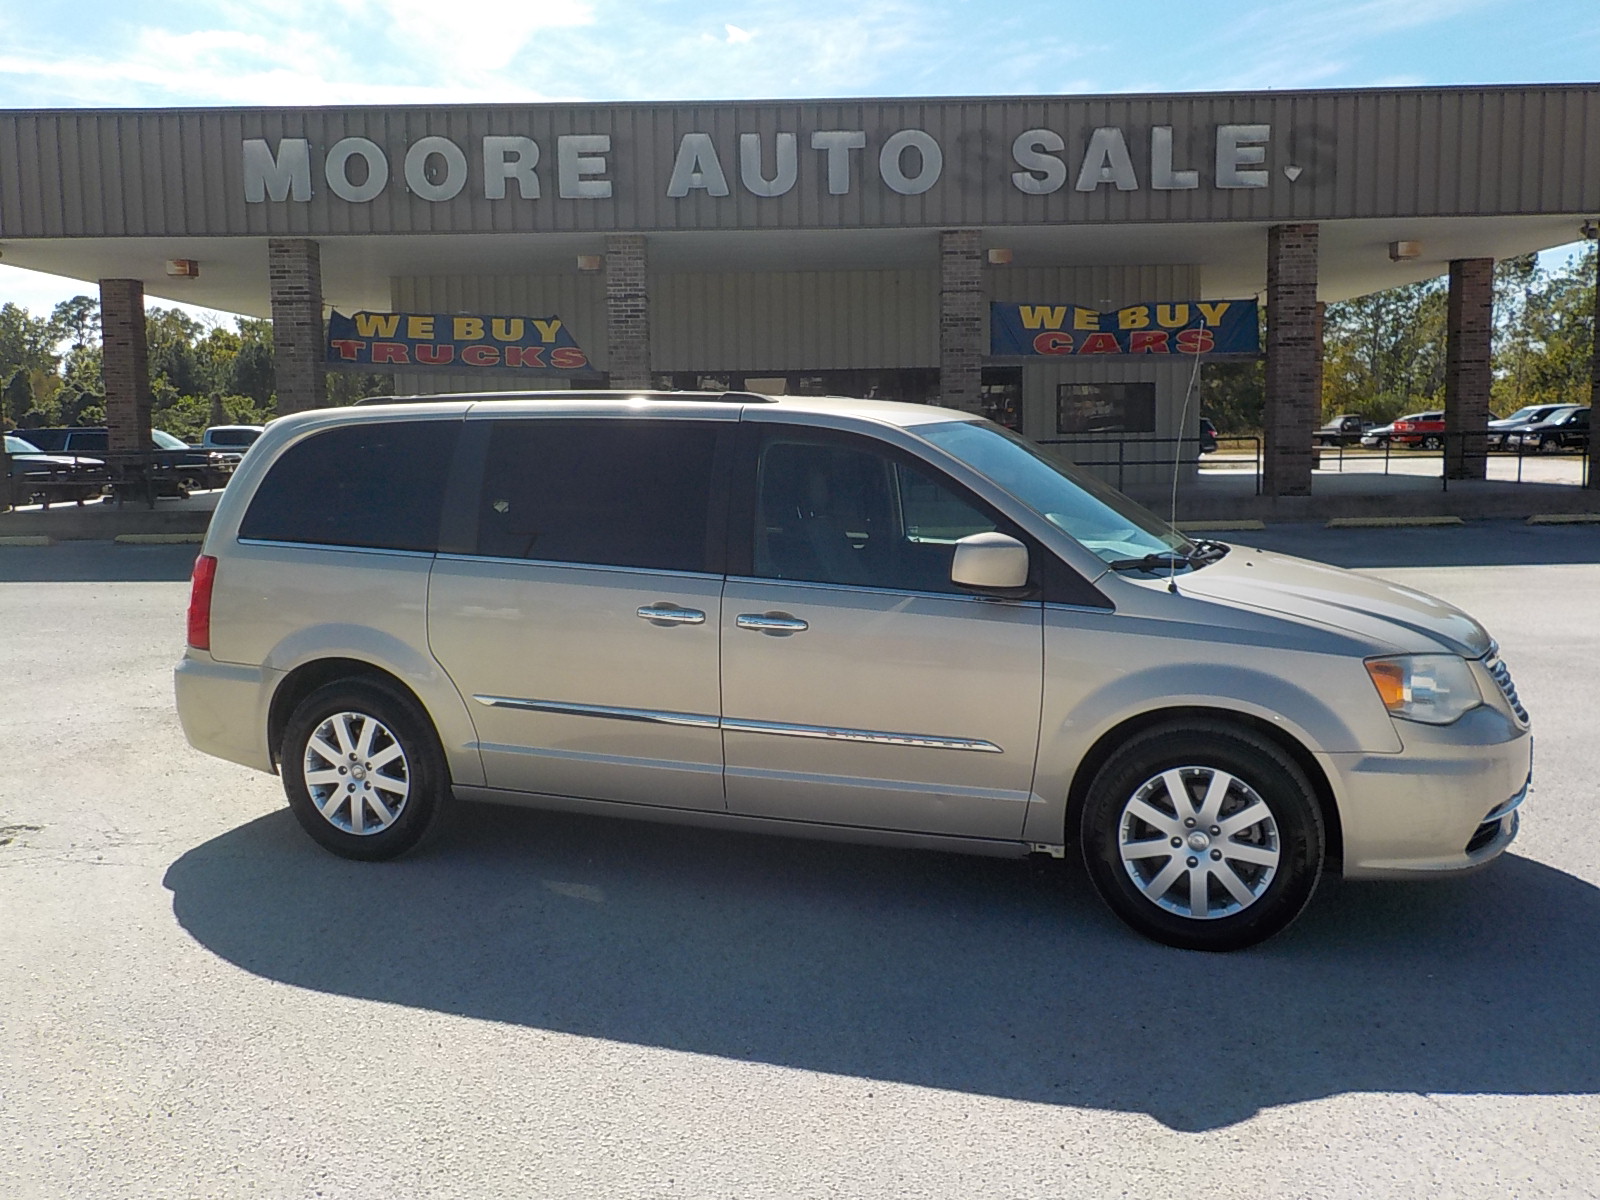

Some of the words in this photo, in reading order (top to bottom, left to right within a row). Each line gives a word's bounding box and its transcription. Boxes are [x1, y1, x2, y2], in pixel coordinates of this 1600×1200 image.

[242, 134, 613, 203] MOORE
[666, 129, 944, 198] AUTO
[354, 313, 435, 340] WE
[453, 316, 562, 344] BUY
[1019, 305, 1100, 331] WE
[1117, 302, 1231, 330] BUY
[331, 339, 588, 369] TRUCKS
[1033, 328, 1215, 355] CARS
